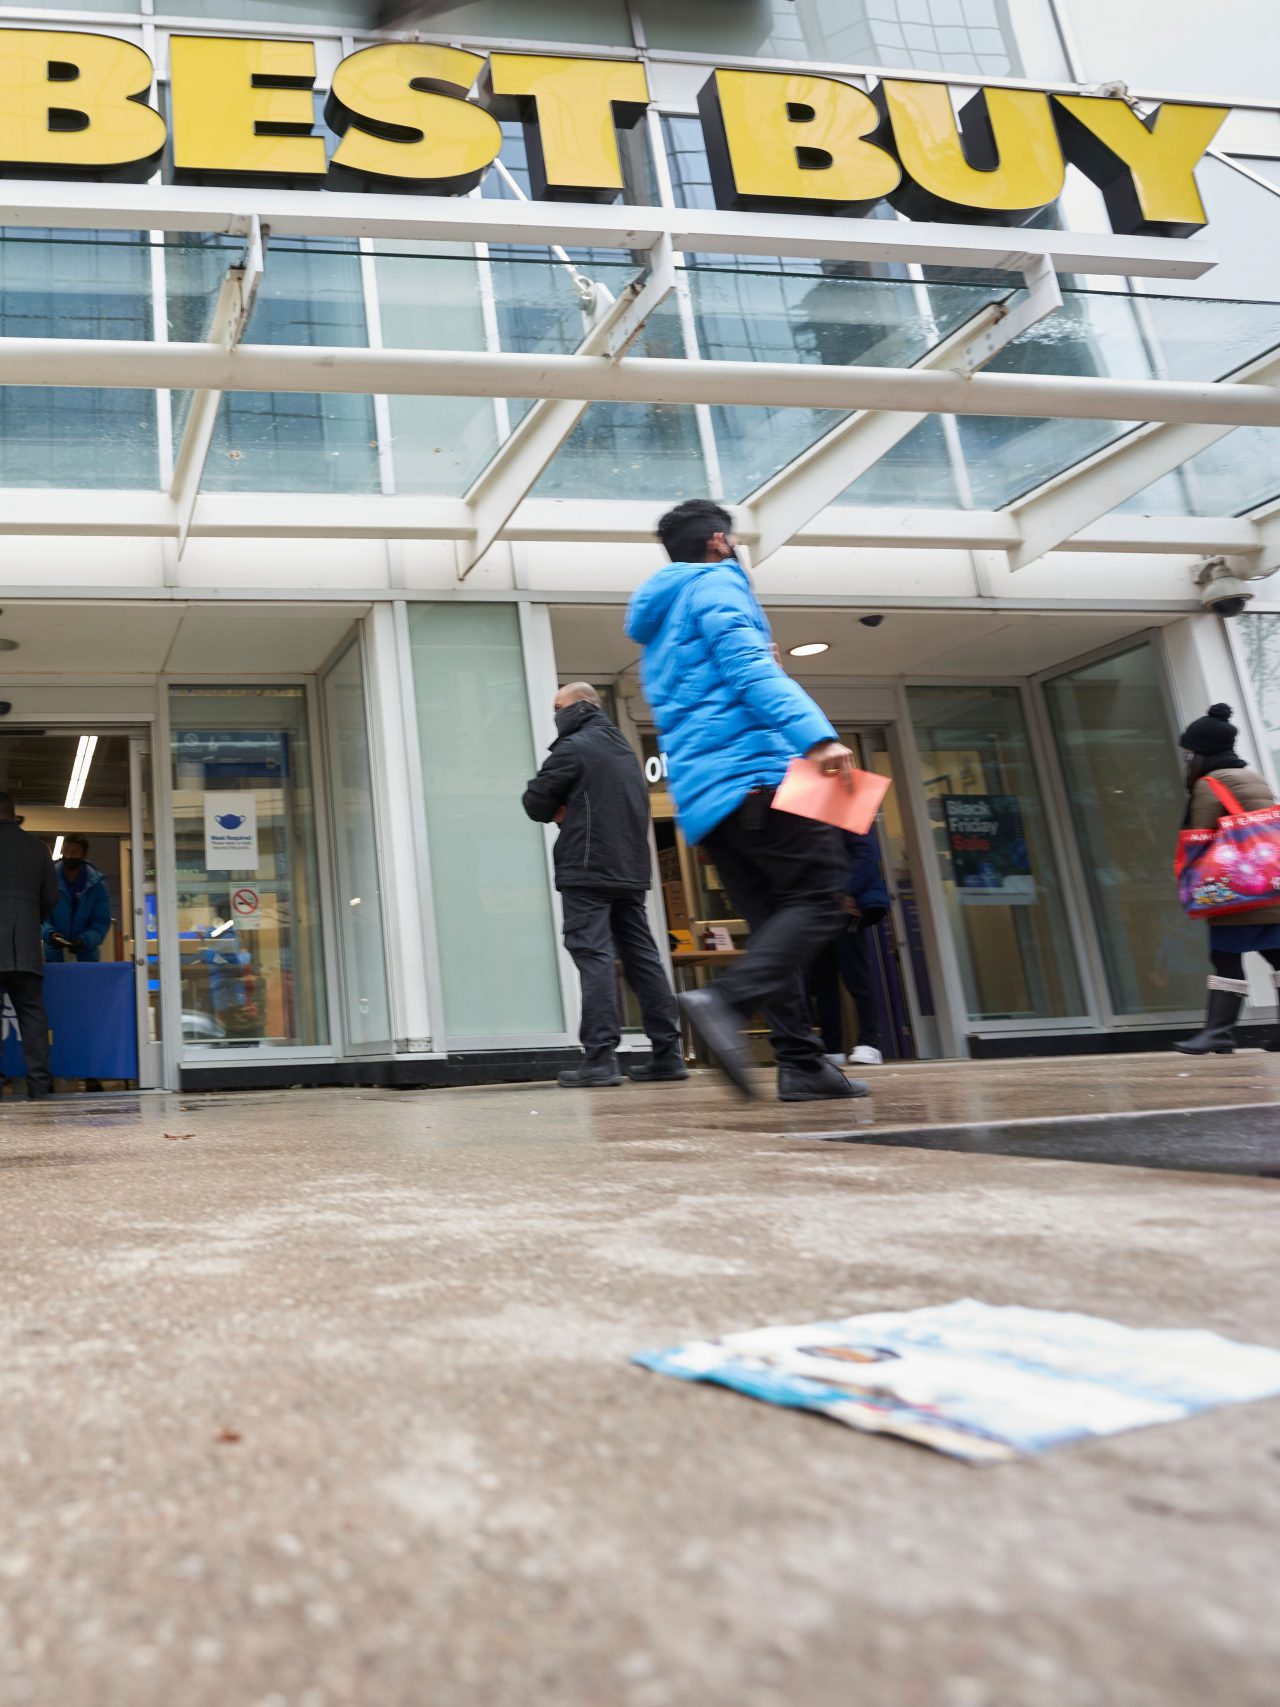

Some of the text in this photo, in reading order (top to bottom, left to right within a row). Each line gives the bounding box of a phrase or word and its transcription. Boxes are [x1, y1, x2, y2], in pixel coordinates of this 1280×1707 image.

[699, 69, 1231, 238] BUY
[946, 800, 991, 816] Black
[950, 818, 999, 836] Friday
